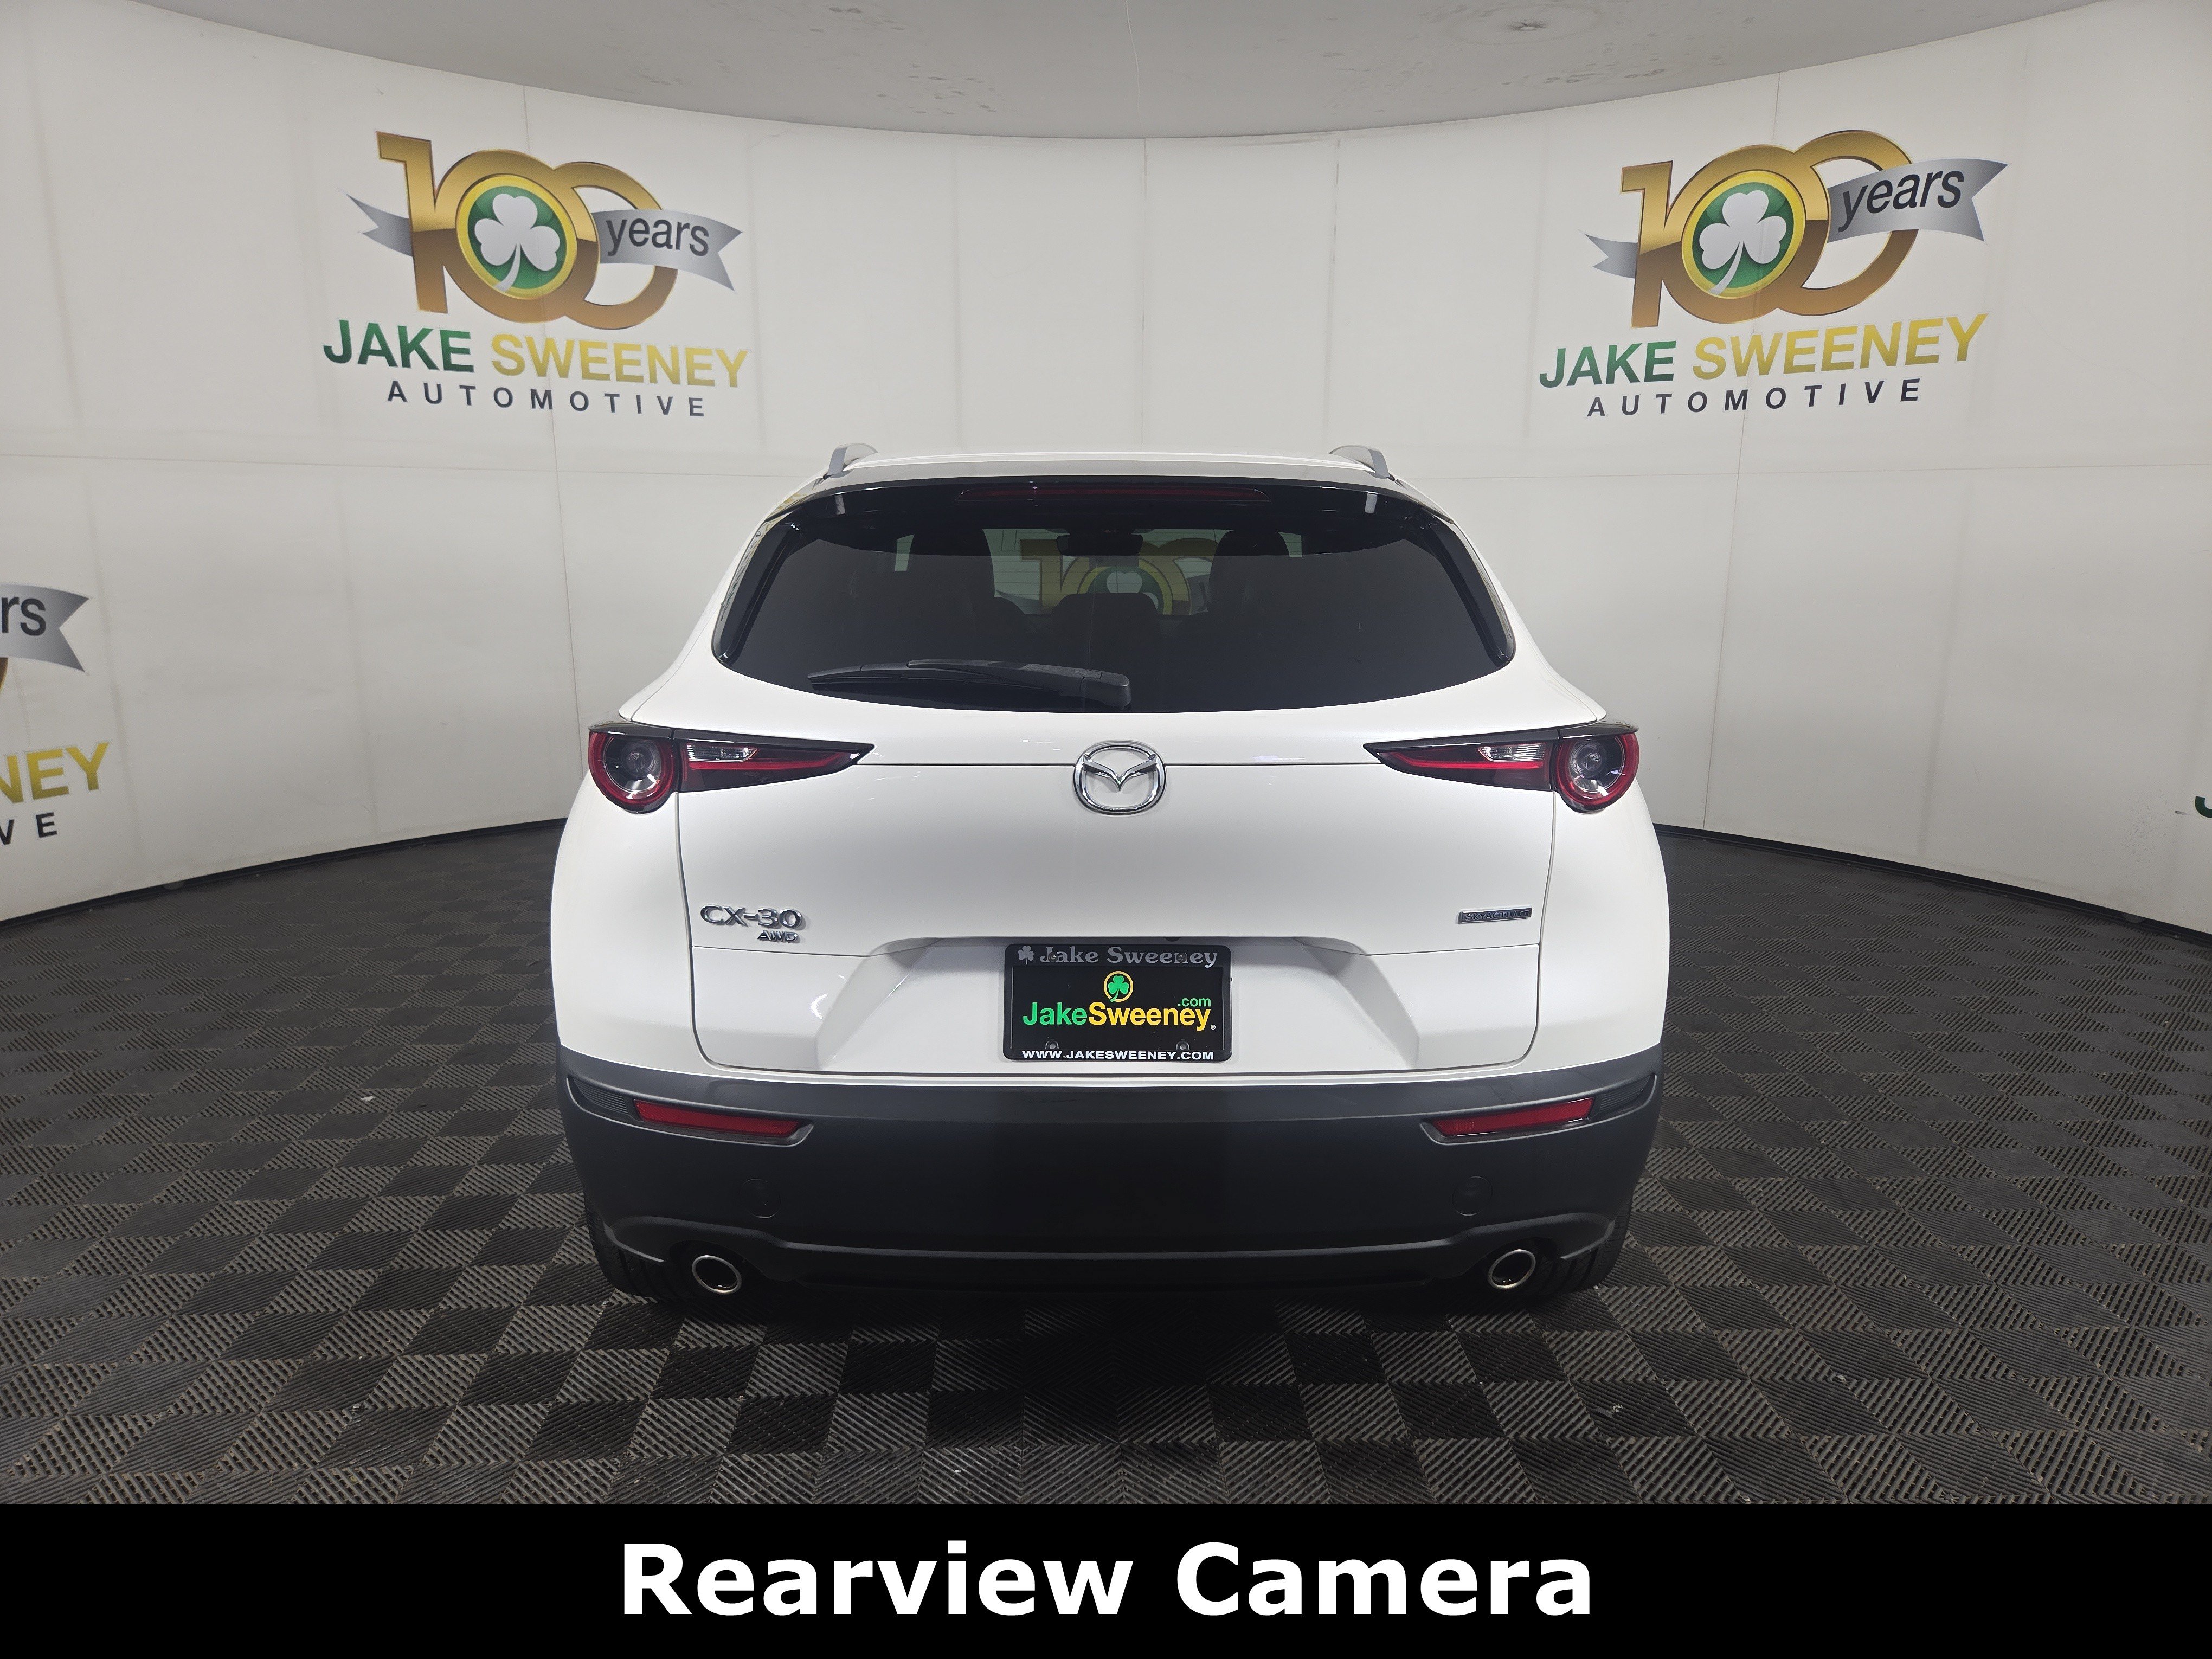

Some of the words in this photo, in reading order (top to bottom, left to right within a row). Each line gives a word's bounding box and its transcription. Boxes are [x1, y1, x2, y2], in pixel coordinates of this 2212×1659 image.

[1838, 169, 1964, 232] years
[376, 131, 678, 330] 100
[606, 217, 710, 256] years
[1621, 130, 1919, 328] 100
[324, 320, 474, 373] JAKE
[492, 333, 748, 388] SWEENEY
[1539, 340, 1676, 388] JAKE
[1693, 313, 1988, 380] SWEENEY
[387, 380, 704, 416] AUTOMOTIVE
[1587, 378, 1920, 417] AUTOMOTIVE
[700, 905, 803, 929] CX-30
[757, 930, 799, 942] AWD
[1040, 946, 1098, 963] Jake
[1107, 946, 1218, 968] Sweeney
[1022, 1050, 1214, 1060] WWW.JAKESWEENEY.COM
